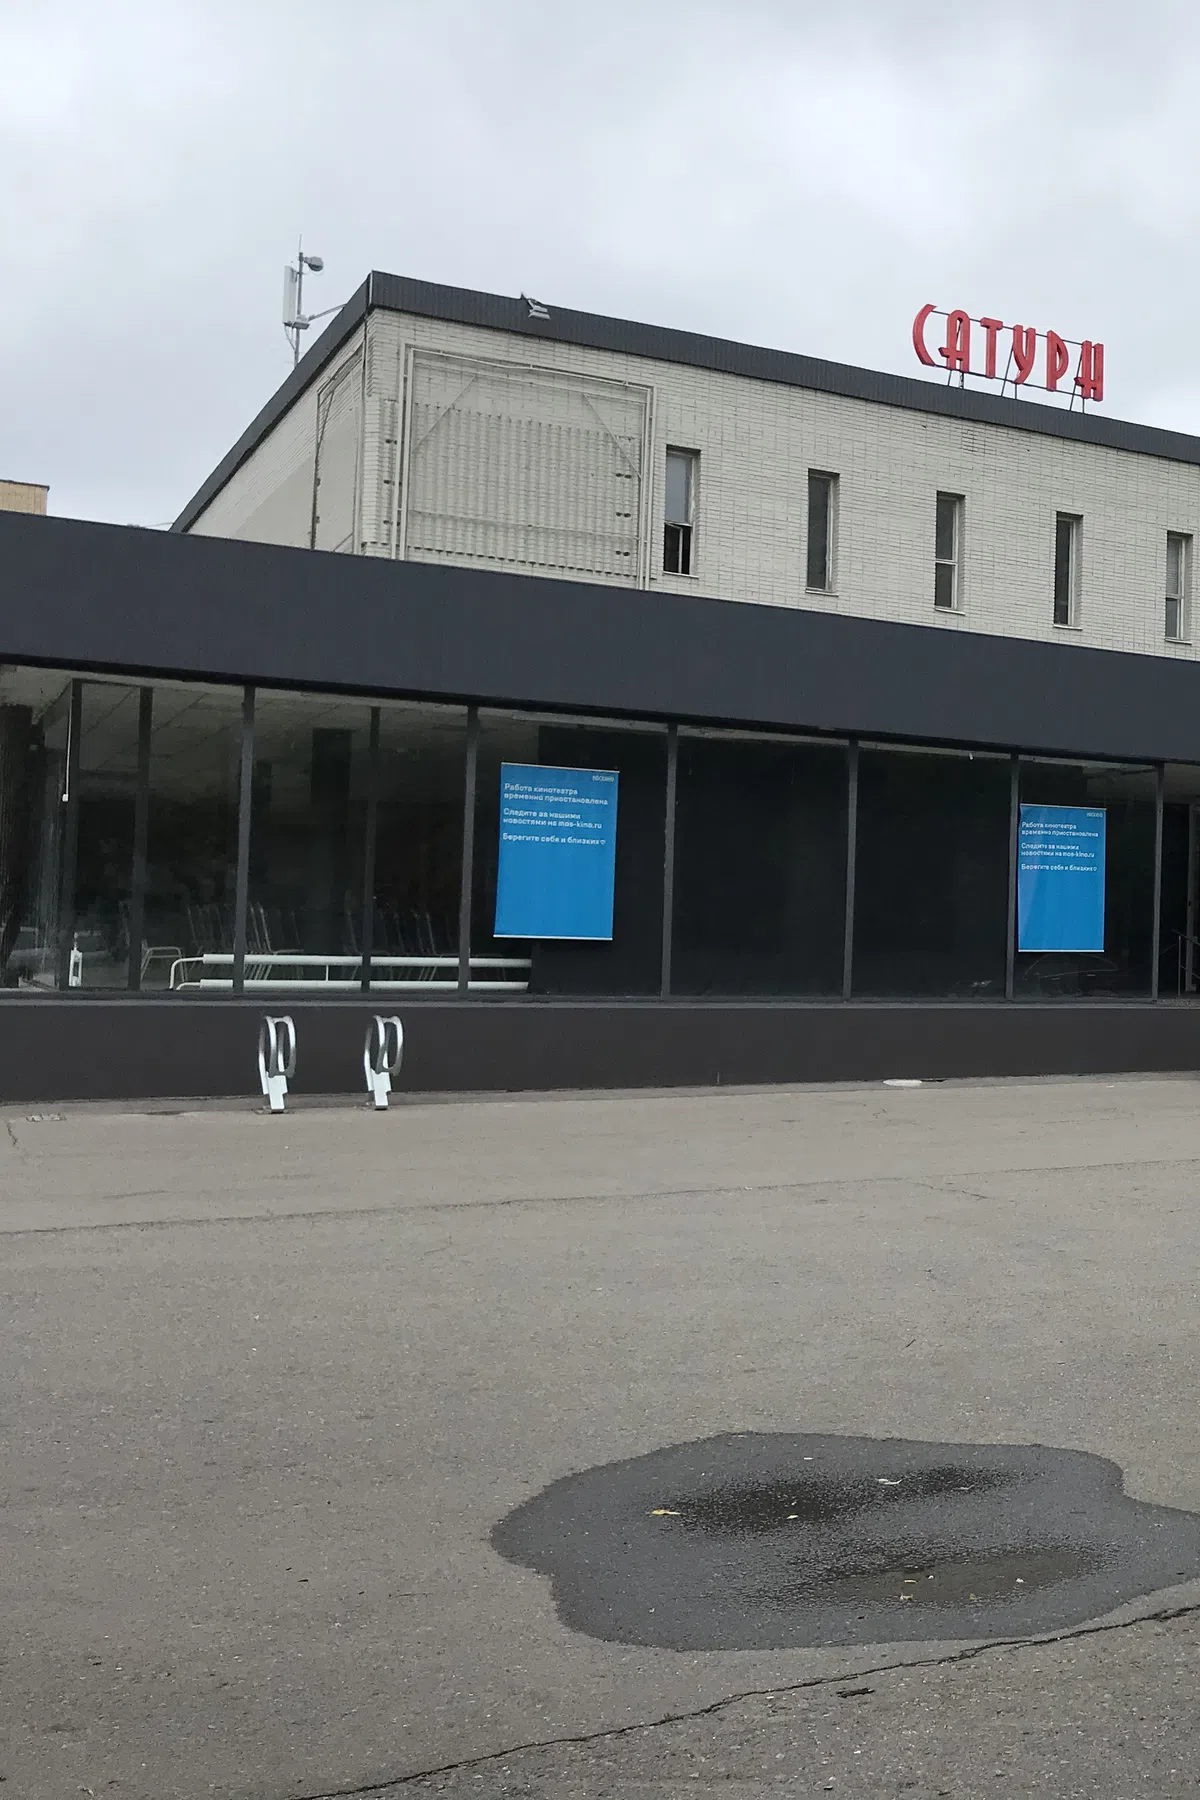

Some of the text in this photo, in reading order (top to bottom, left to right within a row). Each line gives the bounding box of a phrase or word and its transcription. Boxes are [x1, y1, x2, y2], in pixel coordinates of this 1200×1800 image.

[912, 304, 1104, 402] САТУРН
[505, 783, 578, 795] Работа кинотеатра
[504, 793, 608, 805] временно приостановлена
[504, 808, 537, 817] Следите
[558, 821, 602, 829] mos-kino.ru
[503, 833, 539, 842] Берегите
[567, 837, 599, 845] близких
